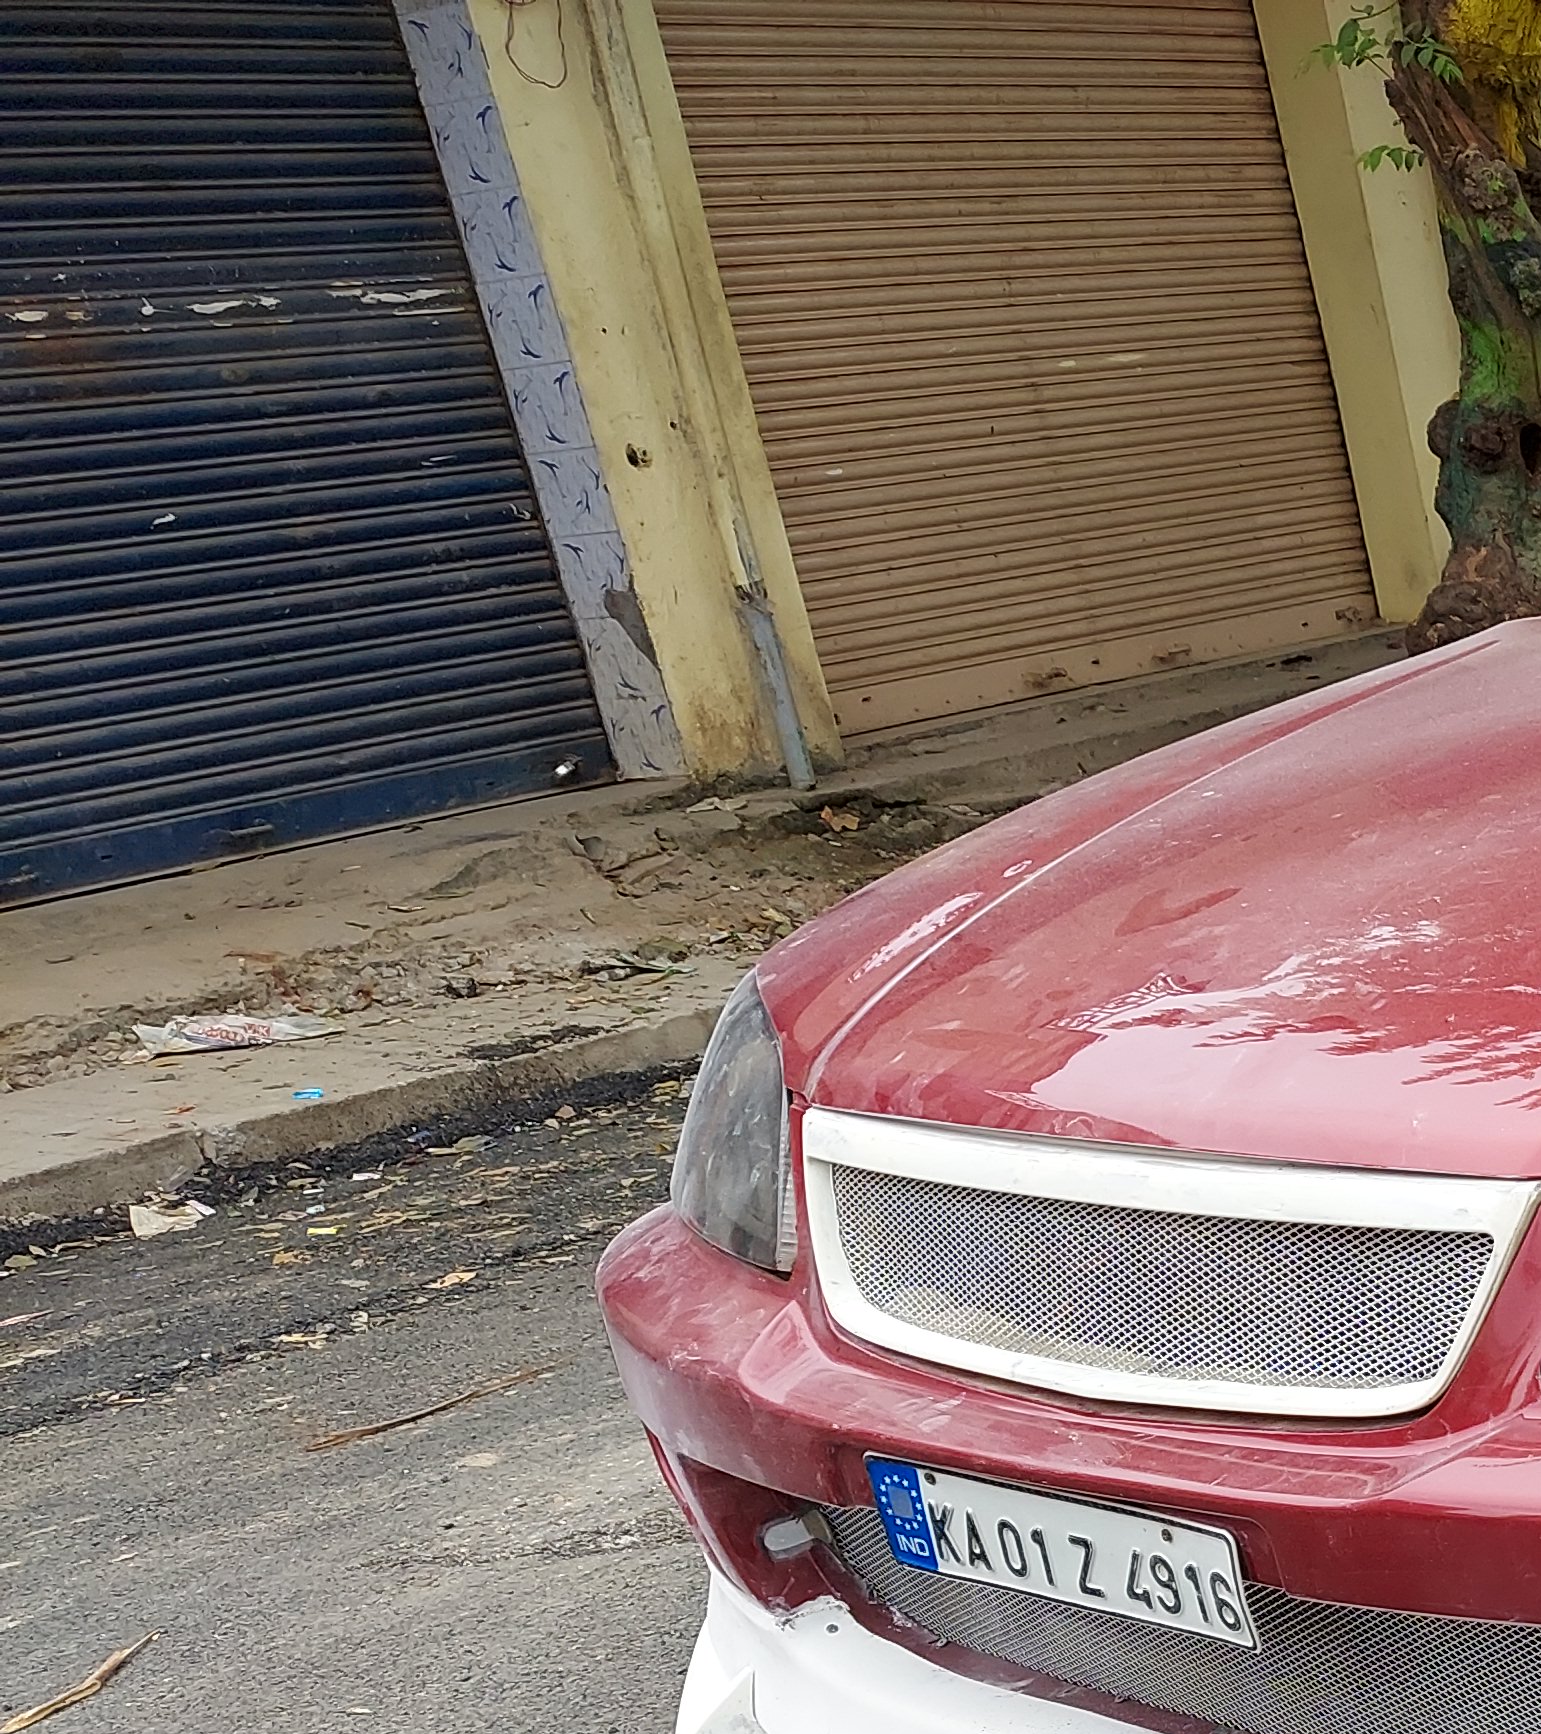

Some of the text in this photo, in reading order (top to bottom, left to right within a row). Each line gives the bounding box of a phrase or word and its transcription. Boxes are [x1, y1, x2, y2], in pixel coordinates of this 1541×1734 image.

[898, 1532, 932, 1558] IND
[1067, 1533, 1107, 1599] Z
[1126, 1548, 1243, 1633] 4916
